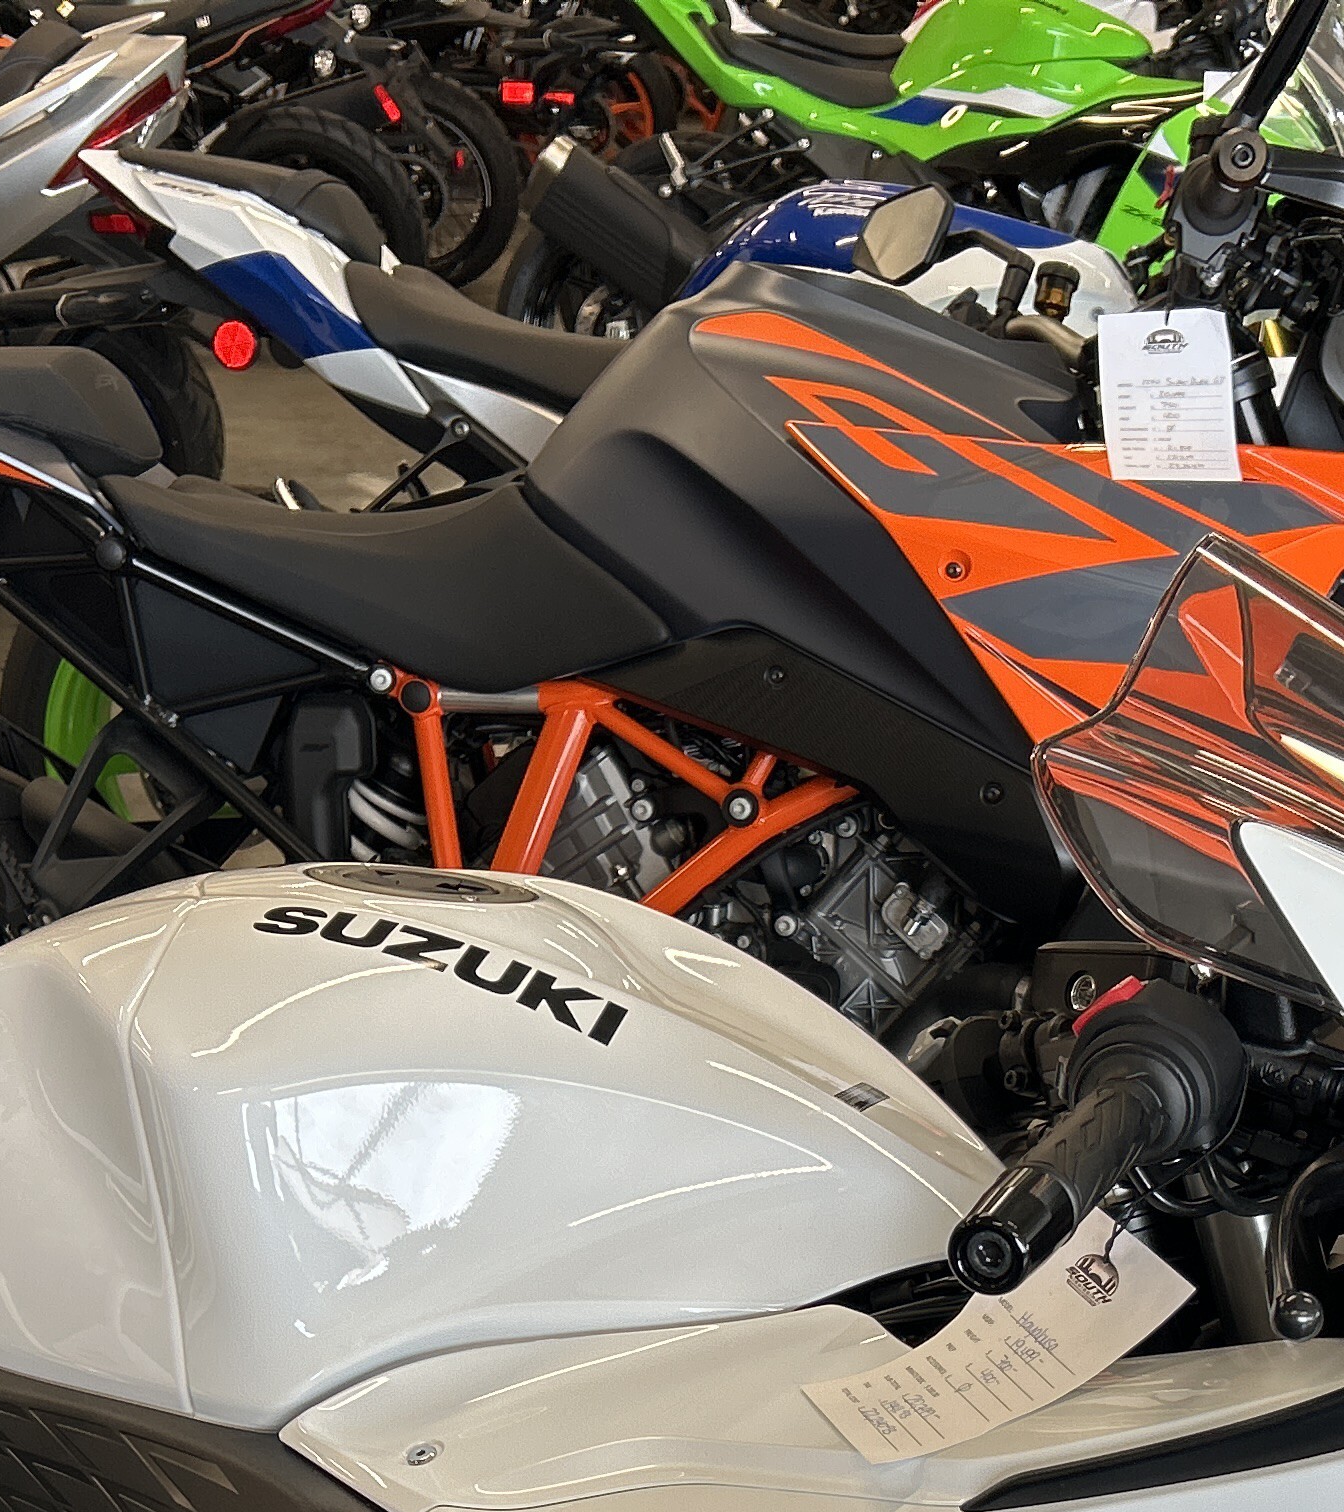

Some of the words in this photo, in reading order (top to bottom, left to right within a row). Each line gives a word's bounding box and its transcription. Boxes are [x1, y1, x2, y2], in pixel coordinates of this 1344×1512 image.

[253, 907, 629, 1047] SUZUKI
[1066, 1266, 1112, 1304] SOUTH
[1017, 1311, 1059, 1351] Hayabusa
